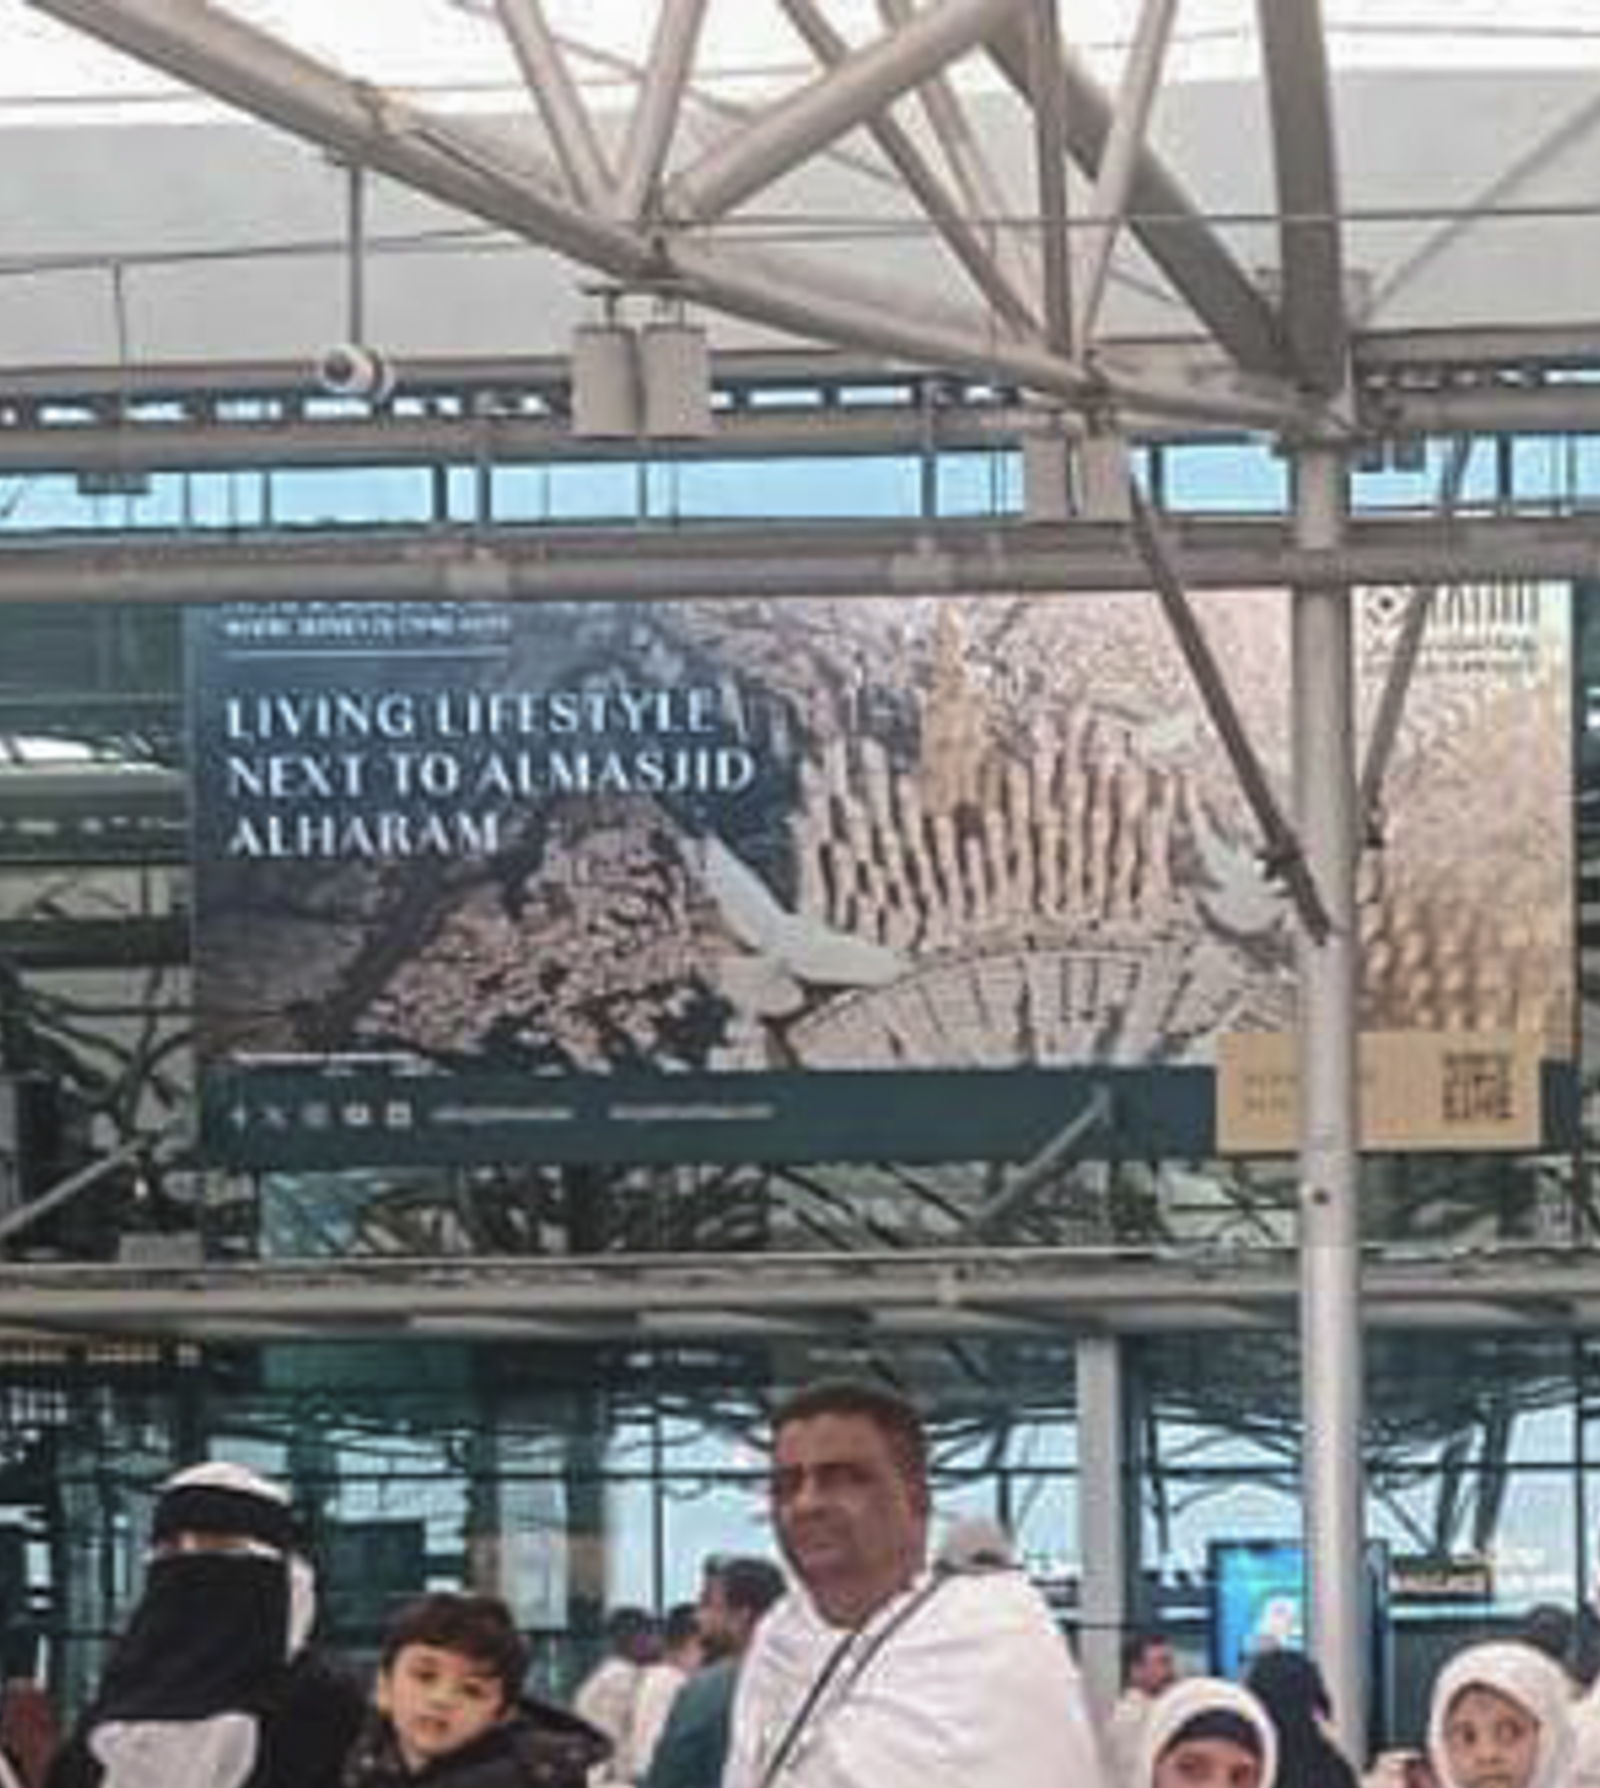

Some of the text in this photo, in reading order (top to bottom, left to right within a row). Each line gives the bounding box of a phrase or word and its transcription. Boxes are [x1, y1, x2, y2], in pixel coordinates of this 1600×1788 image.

[228, 688, 717, 739] LIVING LIFESTYLE
[229, 748, 755, 798] NEXT TO ALMASJID
[229, 811, 499, 857] ALHARAM
